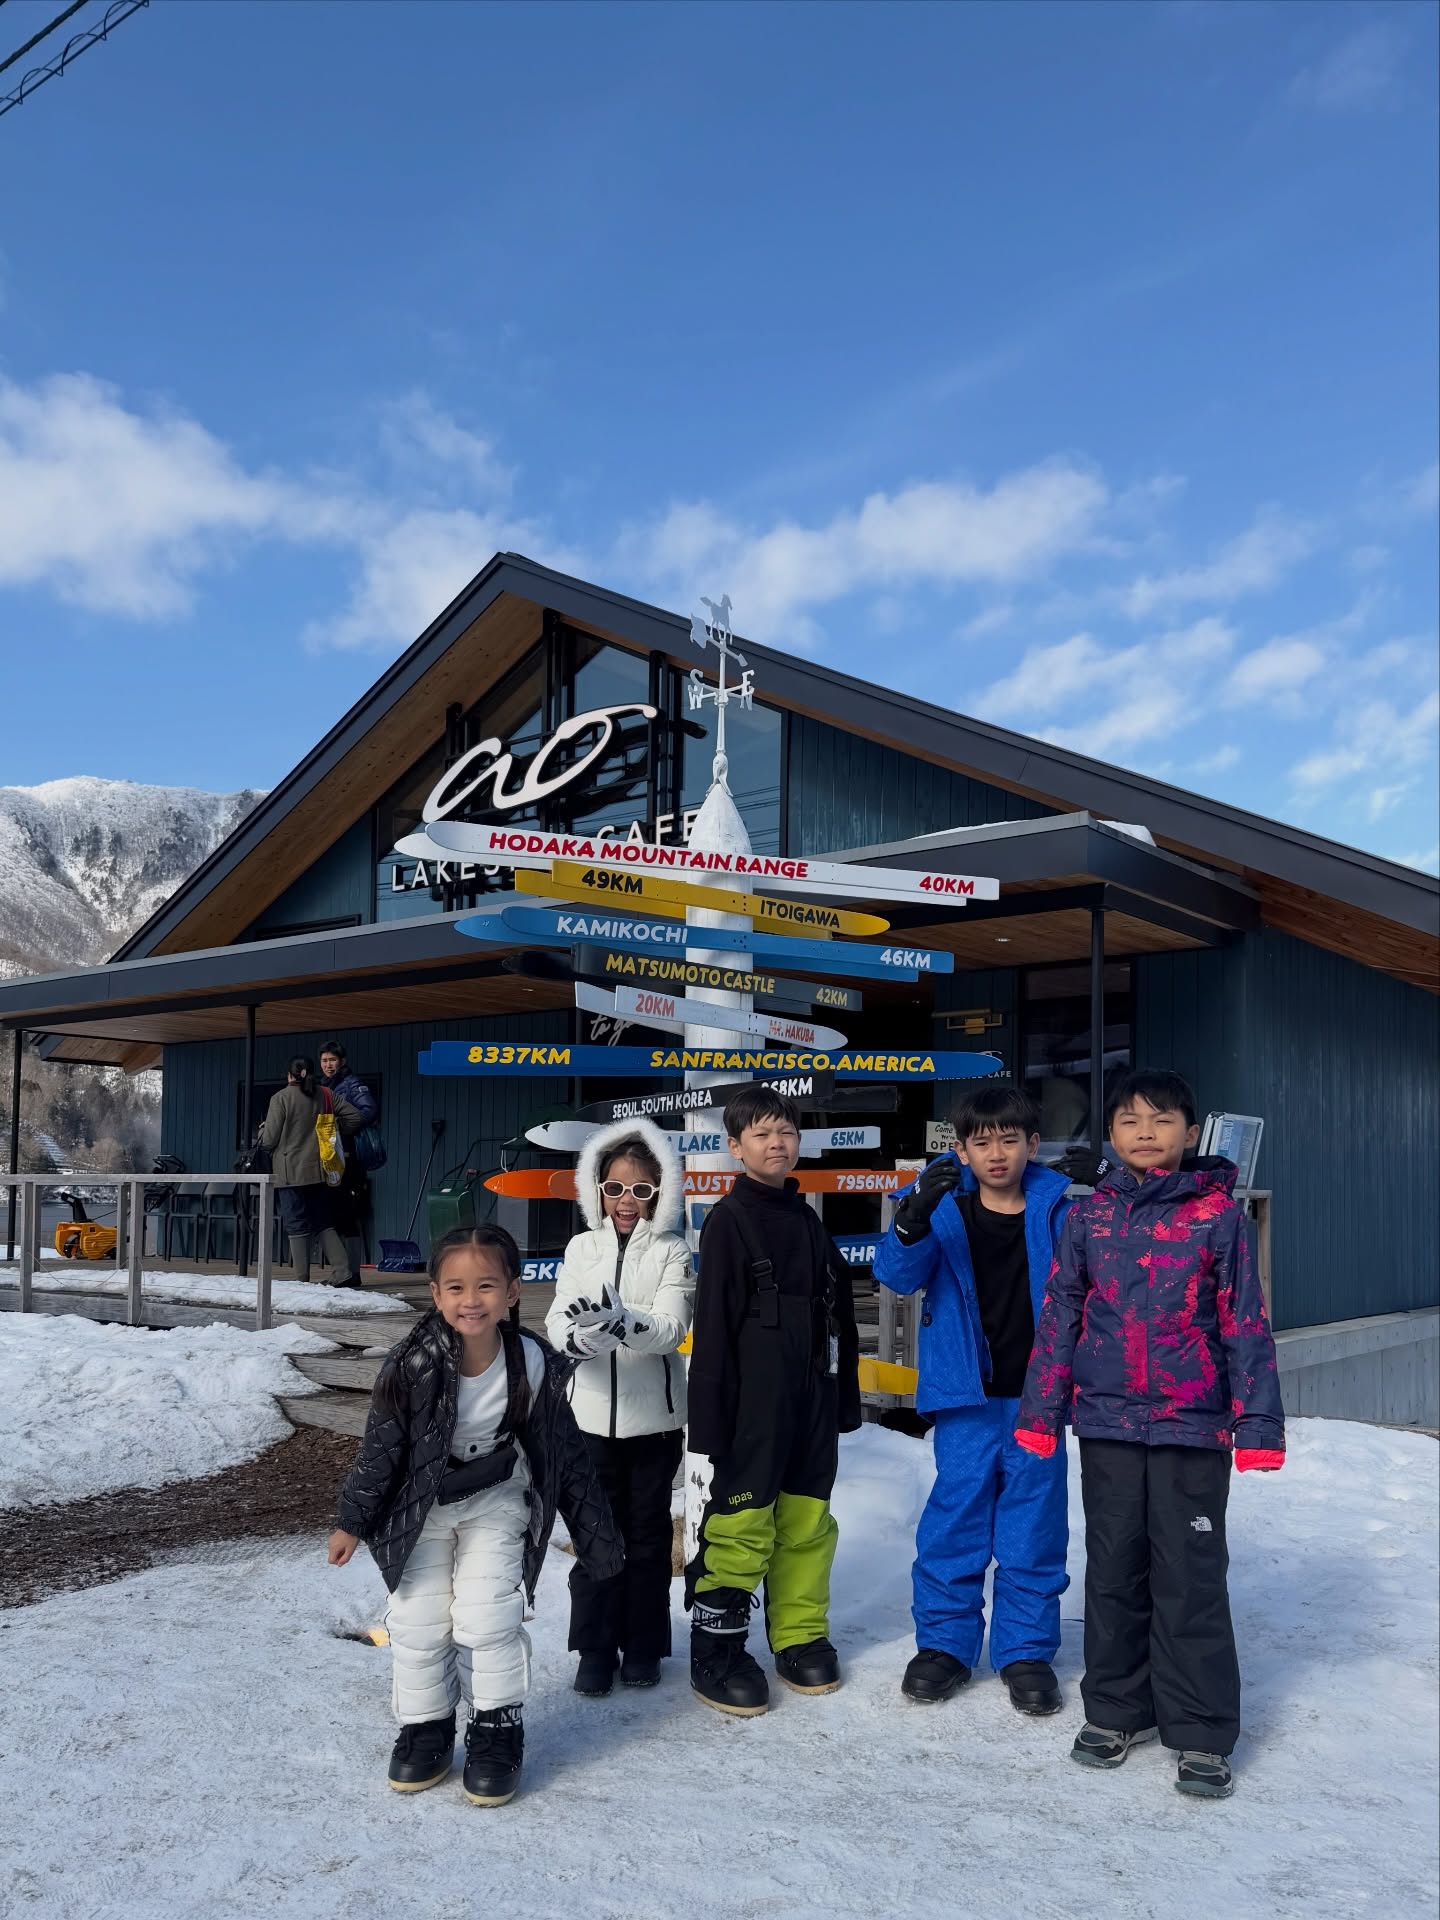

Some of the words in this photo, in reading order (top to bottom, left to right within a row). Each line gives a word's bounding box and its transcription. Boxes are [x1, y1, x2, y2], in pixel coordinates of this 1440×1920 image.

[489, 832, 595, 857] HODAKA
[600, 840, 731, 872] MOUNTAIN
[735, 856, 808, 879] RANGE
[919, 875, 975, 895] 40KM
[581, 869, 643, 894] 49KM
[760, 899, 840, 929] ITOIGAWA
[556, 916, 688, 944] KAMIKOCHI
[880, 949, 931, 969] 46KM
[605, 953, 721, 986] MATSUMOTO
[723, 971, 776, 994] CASTLE
[816, 987, 848, 1006] 42KM
[635, 993, 675, 1018] 20KM
[785, 1024, 815, 1044] HAKUBA
[467, 1046, 571, 1065] 8337KM
[675, 1089, 713, 1110] KOREA
[935, 1124, 954, 1134] Come
[677, 1134, 722, 1153] LAKE
[831, 1130, 865, 1147] 65KM
[930, 1140, 954, 1152] OPE
[682, 1175, 736, 1192] AUST
[836, 1174, 899, 1190] 7956KM
[728, 1491, 753, 1506] upas
